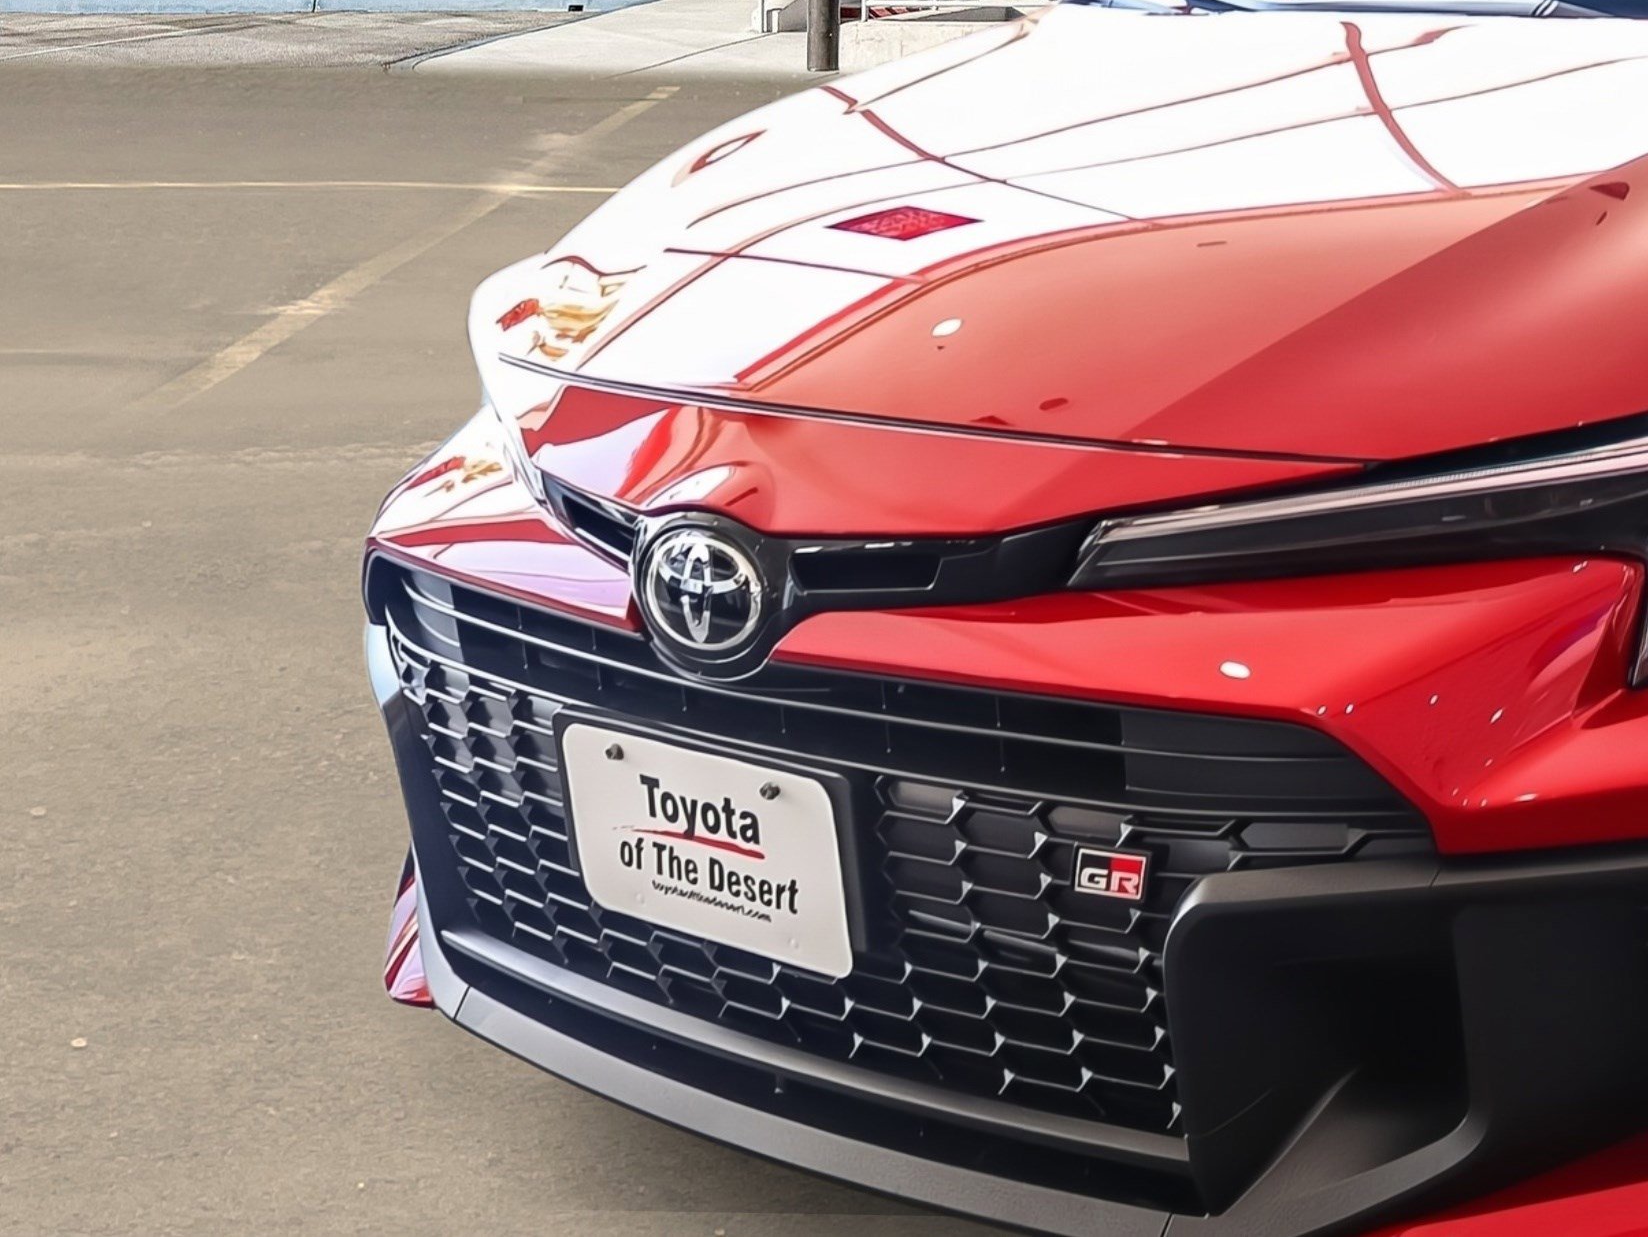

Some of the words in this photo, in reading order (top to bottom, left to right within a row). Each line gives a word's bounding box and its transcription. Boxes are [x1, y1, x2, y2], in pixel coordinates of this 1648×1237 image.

[639, 773, 761, 845] Toyota
[619, 838, 644, 870] of
[652, 841, 699, 885] The
[709, 857, 799, 915] Desert
[1080, 867, 1139, 895] GR
